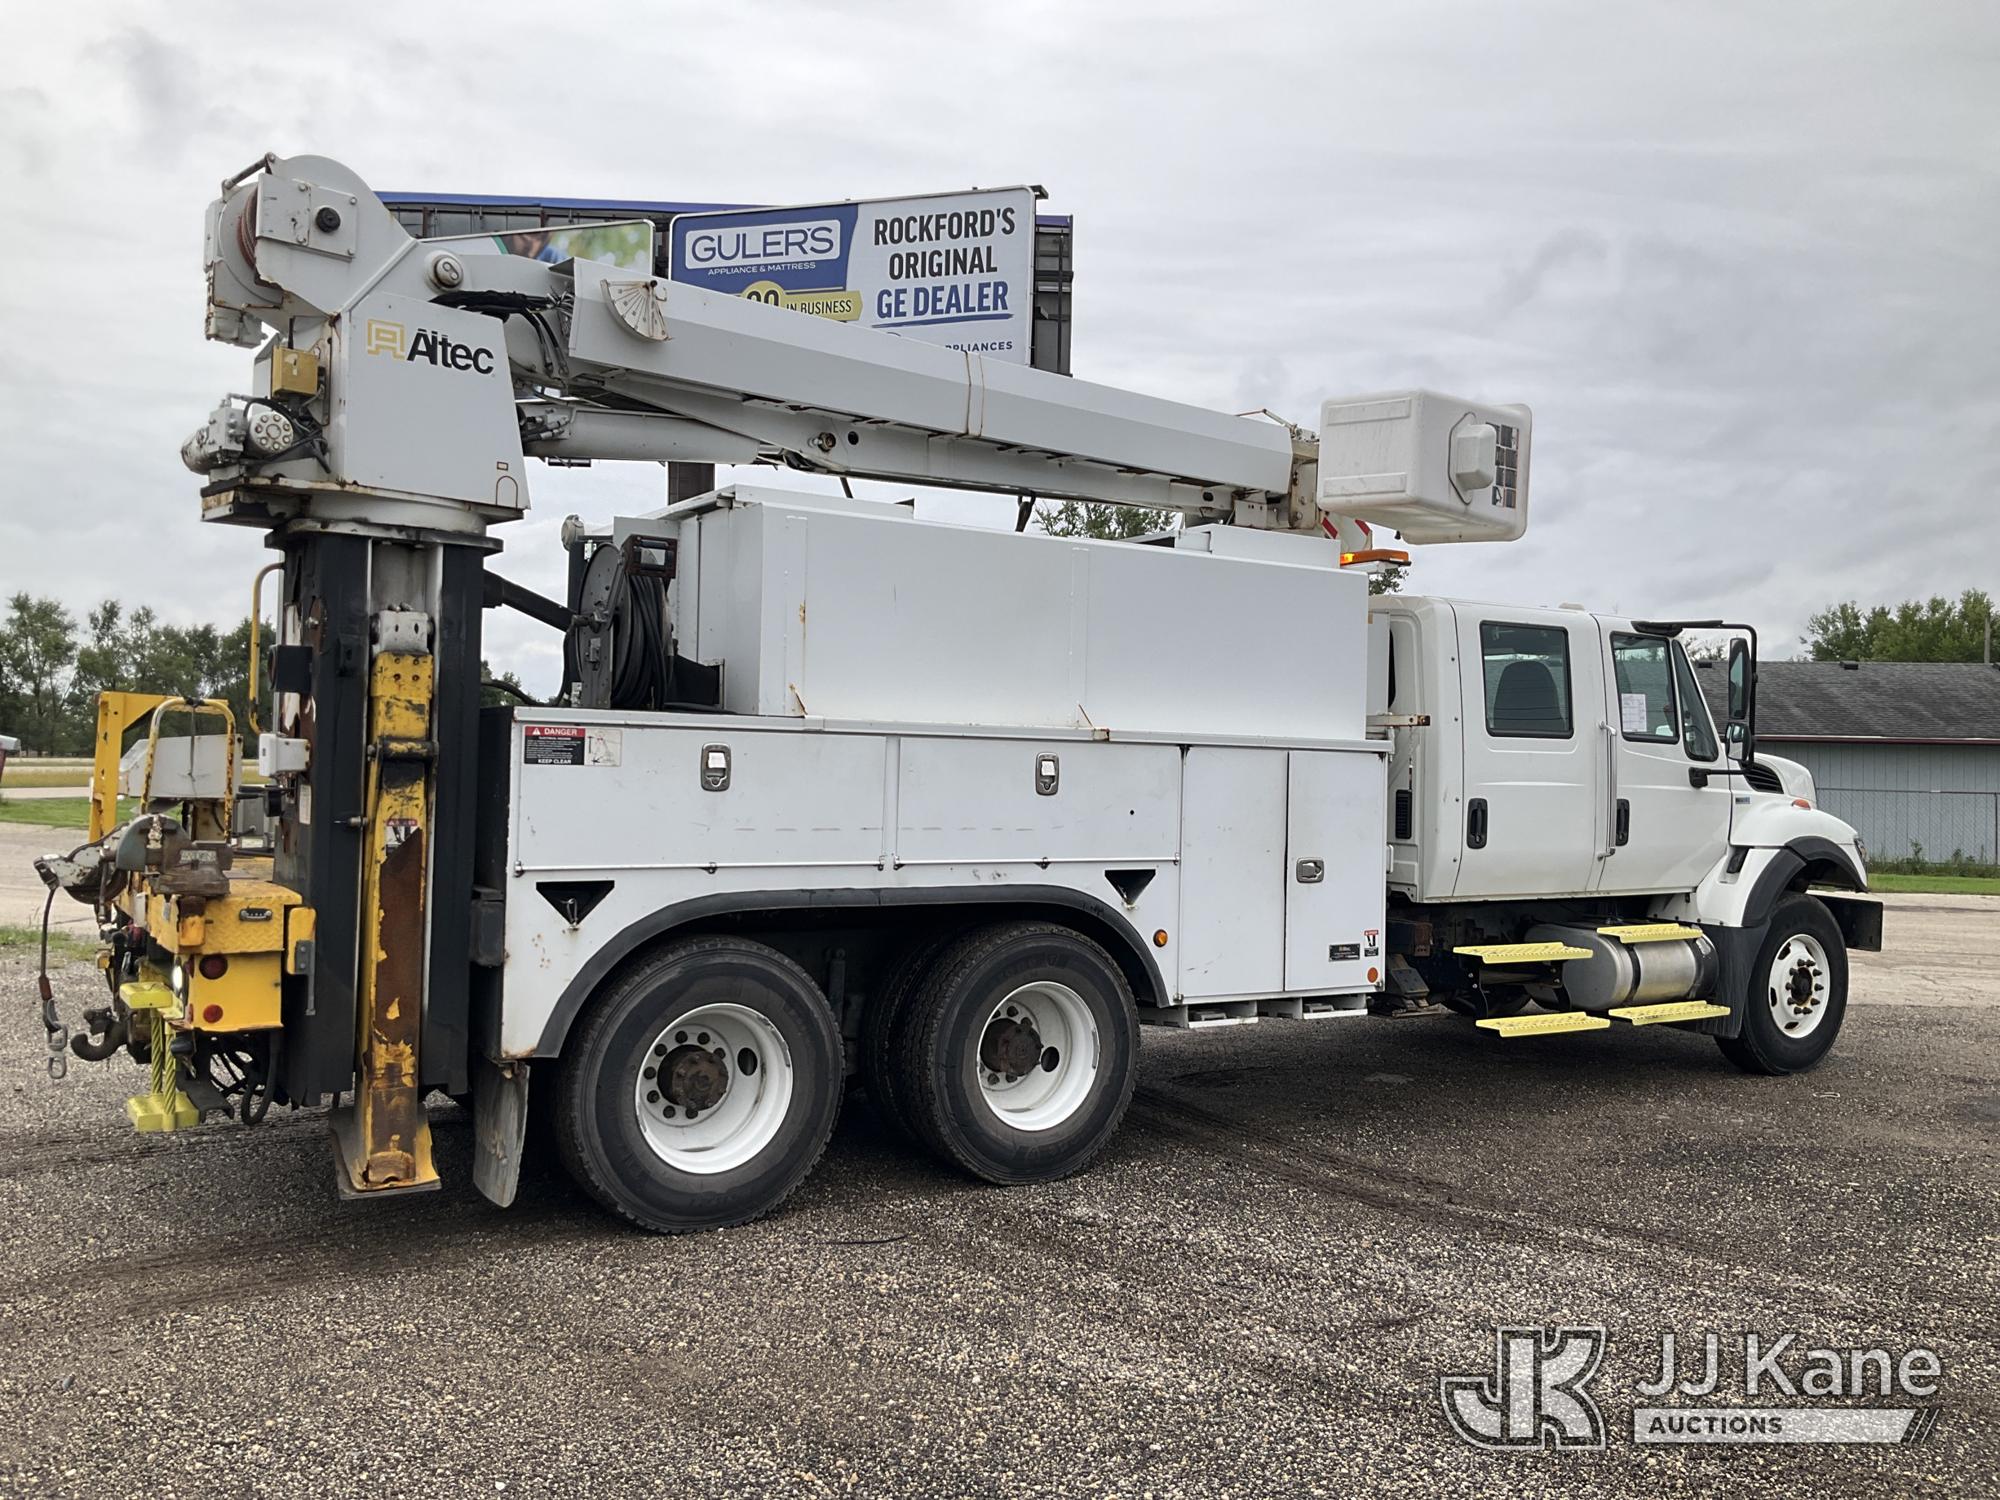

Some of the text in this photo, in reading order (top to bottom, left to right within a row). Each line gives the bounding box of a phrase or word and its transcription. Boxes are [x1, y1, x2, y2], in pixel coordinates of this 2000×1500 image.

[691, 226, 834, 263] GULER'S
[874, 207, 1015, 246] ROCKFORD'S
[708, 261, 817, 276] APPLIANCE & MATTRESS
[889, 245, 998, 281] ORIGINAL
[877, 281, 1009, 319] GE DEALER
[406, 328, 495, 375] Altec
